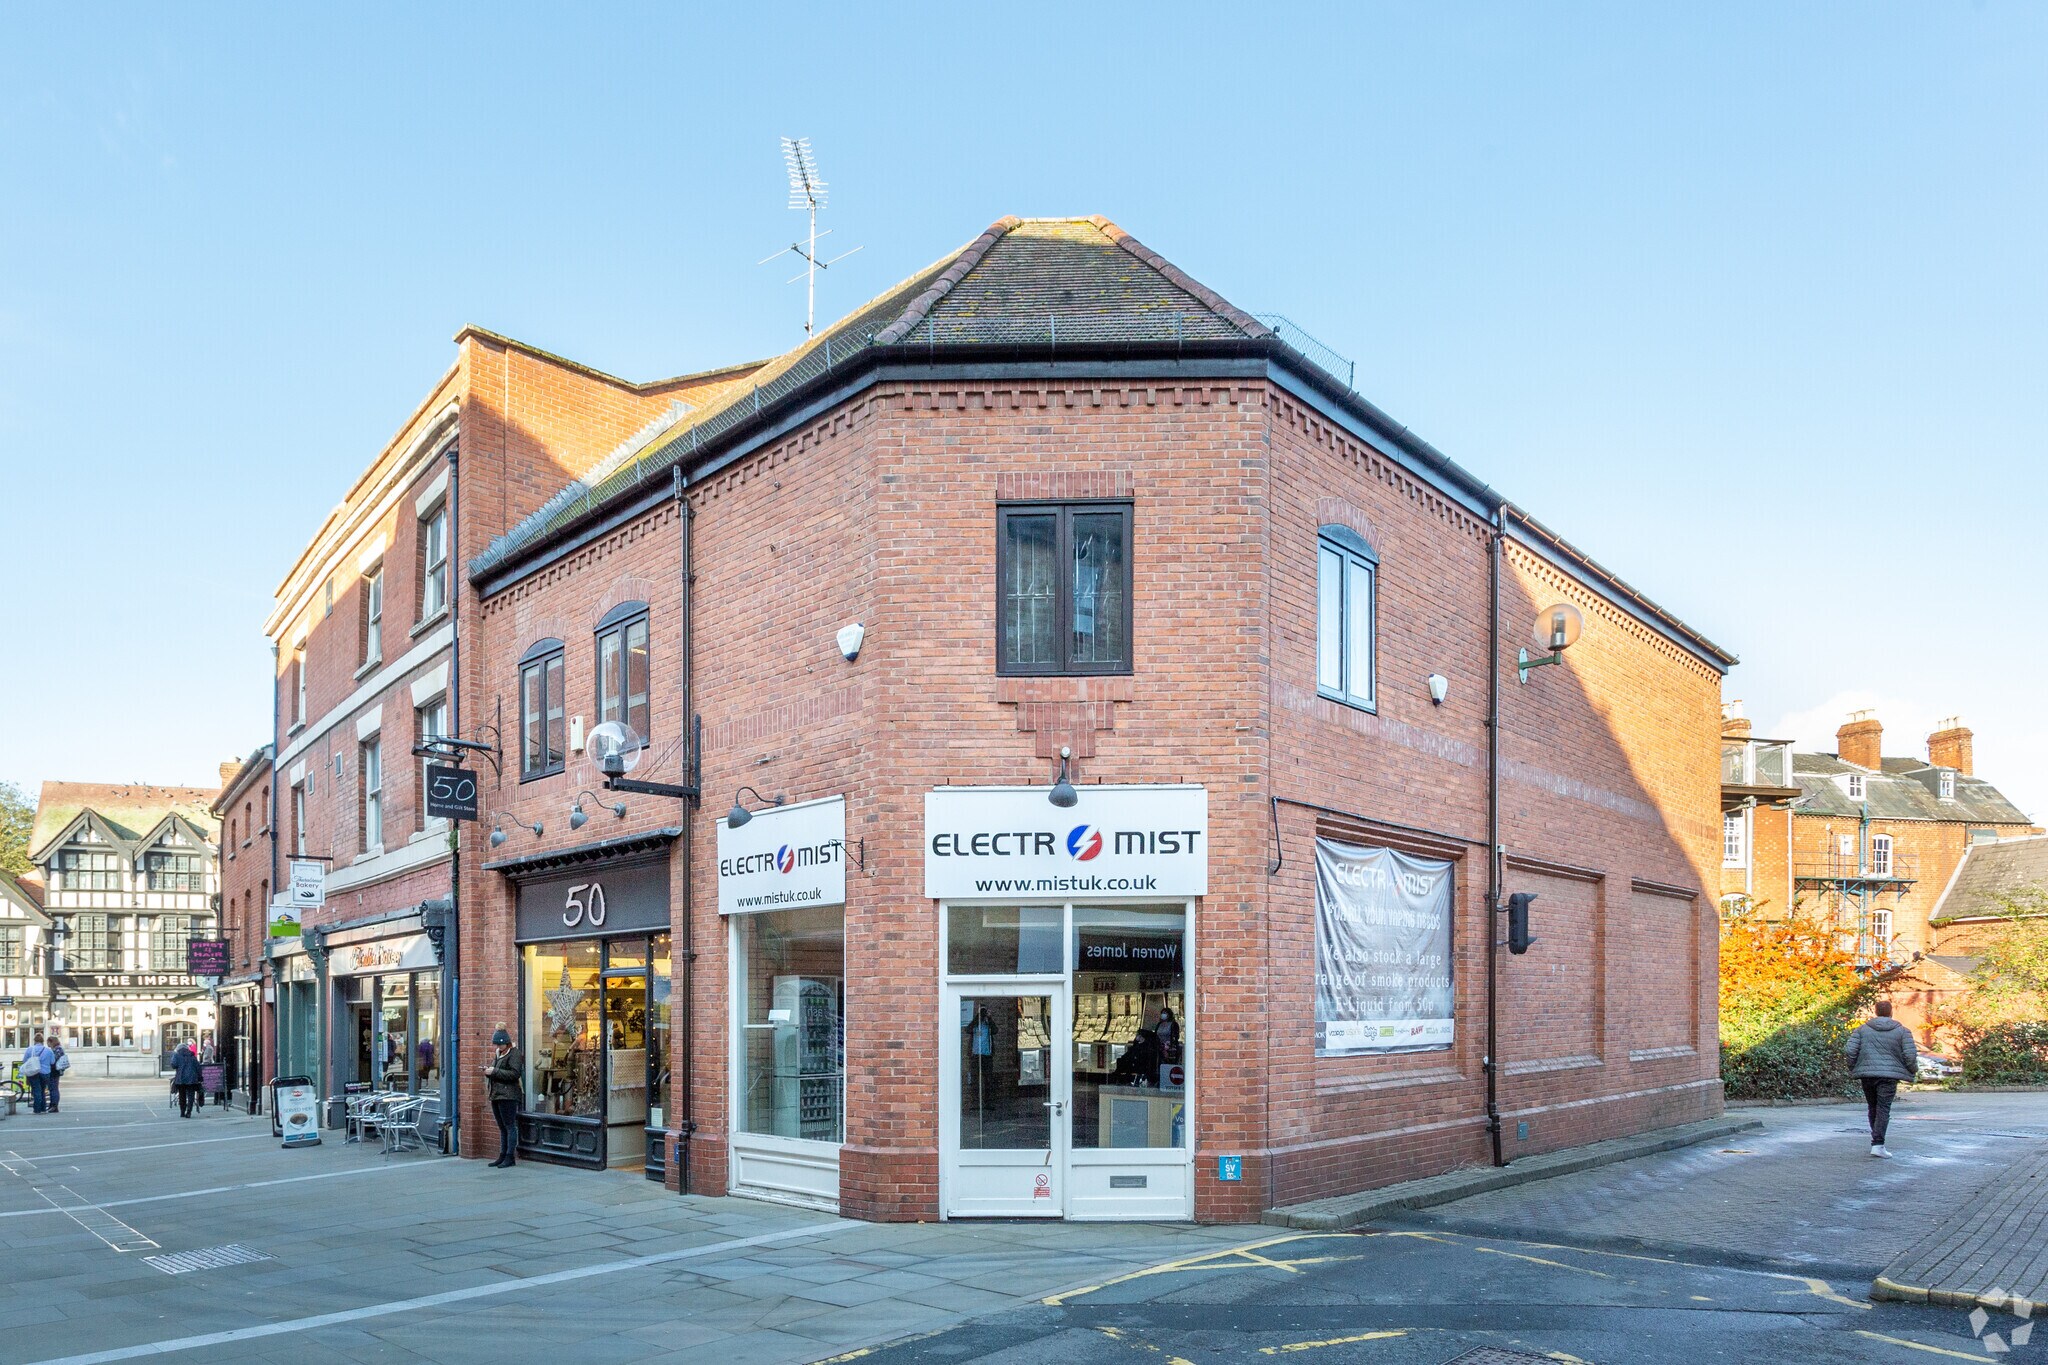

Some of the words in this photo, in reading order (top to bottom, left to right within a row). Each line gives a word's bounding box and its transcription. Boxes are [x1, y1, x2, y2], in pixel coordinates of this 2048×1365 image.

[430, 776, 475, 801] 50
[1115, 831, 1201, 855] MIST
[798, 843, 842, 867] MIST
[975, 875, 1157, 892] www.mistuk.co.uk
[563, 883, 605, 927] 50
[737, 887, 822, 907] www.mistuk.co.uk
[1365, 906, 1386, 925] YOUR
[1388, 909, 1416, 928] VAPING
[1417, 914, 1440, 930] NEEDS
[1324, 944, 1341, 960] We
[1345, 947, 1369, 962] also
[1373, 948, 1403, 963] stock
[1405, 953, 1412, 965] a
[1417, 950, 1441, 969] large
[94, 976, 131, 986] THE
[137, 975, 196, 986] IMPERI
[1315, 973, 1349, 989] range
[1355, 971, 1366, 986] of
[1371, 973, 1403, 987] smoke
[1408, 974, 1450, 991] products
[1336, 996, 1383, 1015] E-Liquid
[1388, 997, 1412, 1011] from
[1416, 997, 1434, 1014] 50p
[1225, 1164, 1236, 1172] SV
